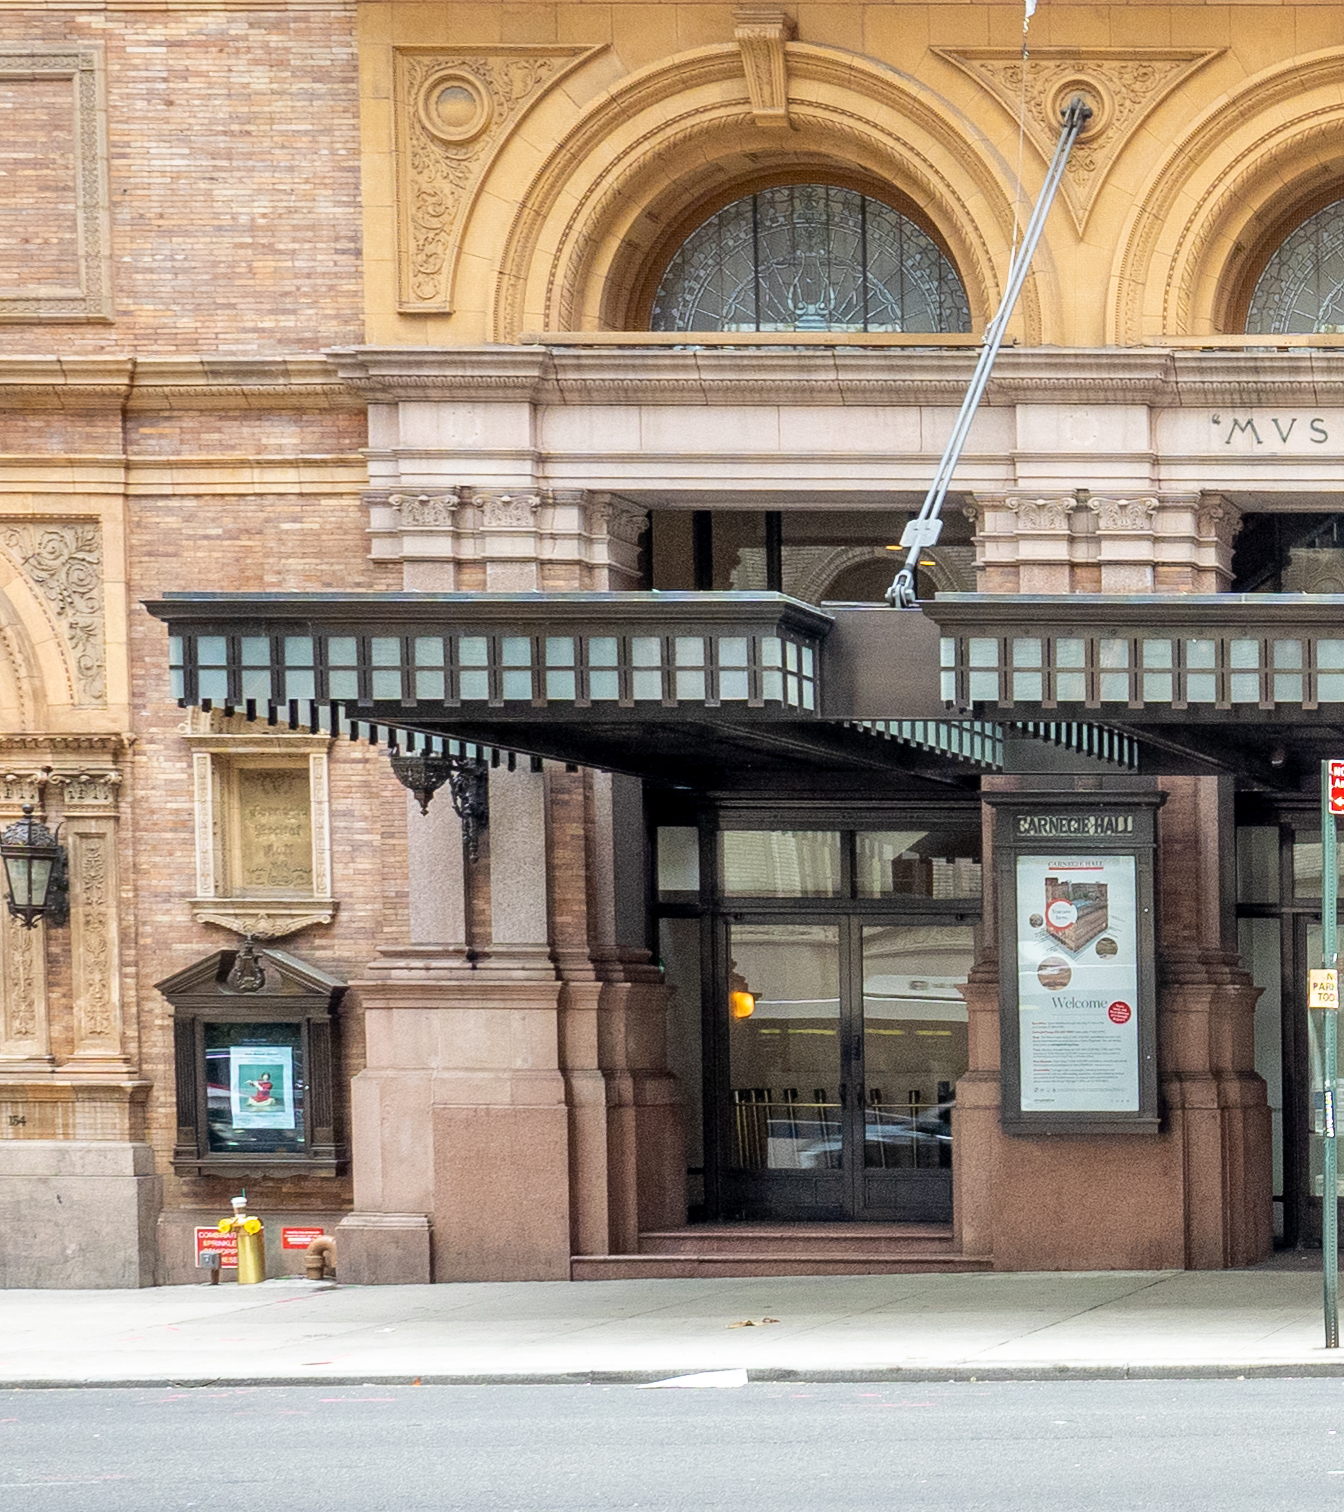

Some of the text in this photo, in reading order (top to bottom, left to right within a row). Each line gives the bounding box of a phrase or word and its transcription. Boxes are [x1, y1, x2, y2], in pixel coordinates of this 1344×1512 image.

[1018, 816, 1133, 835] CARNEGIE HALL
[1051, 996, 1108, 1009] Welcome
[8, 1115, 27, 1127] 154
